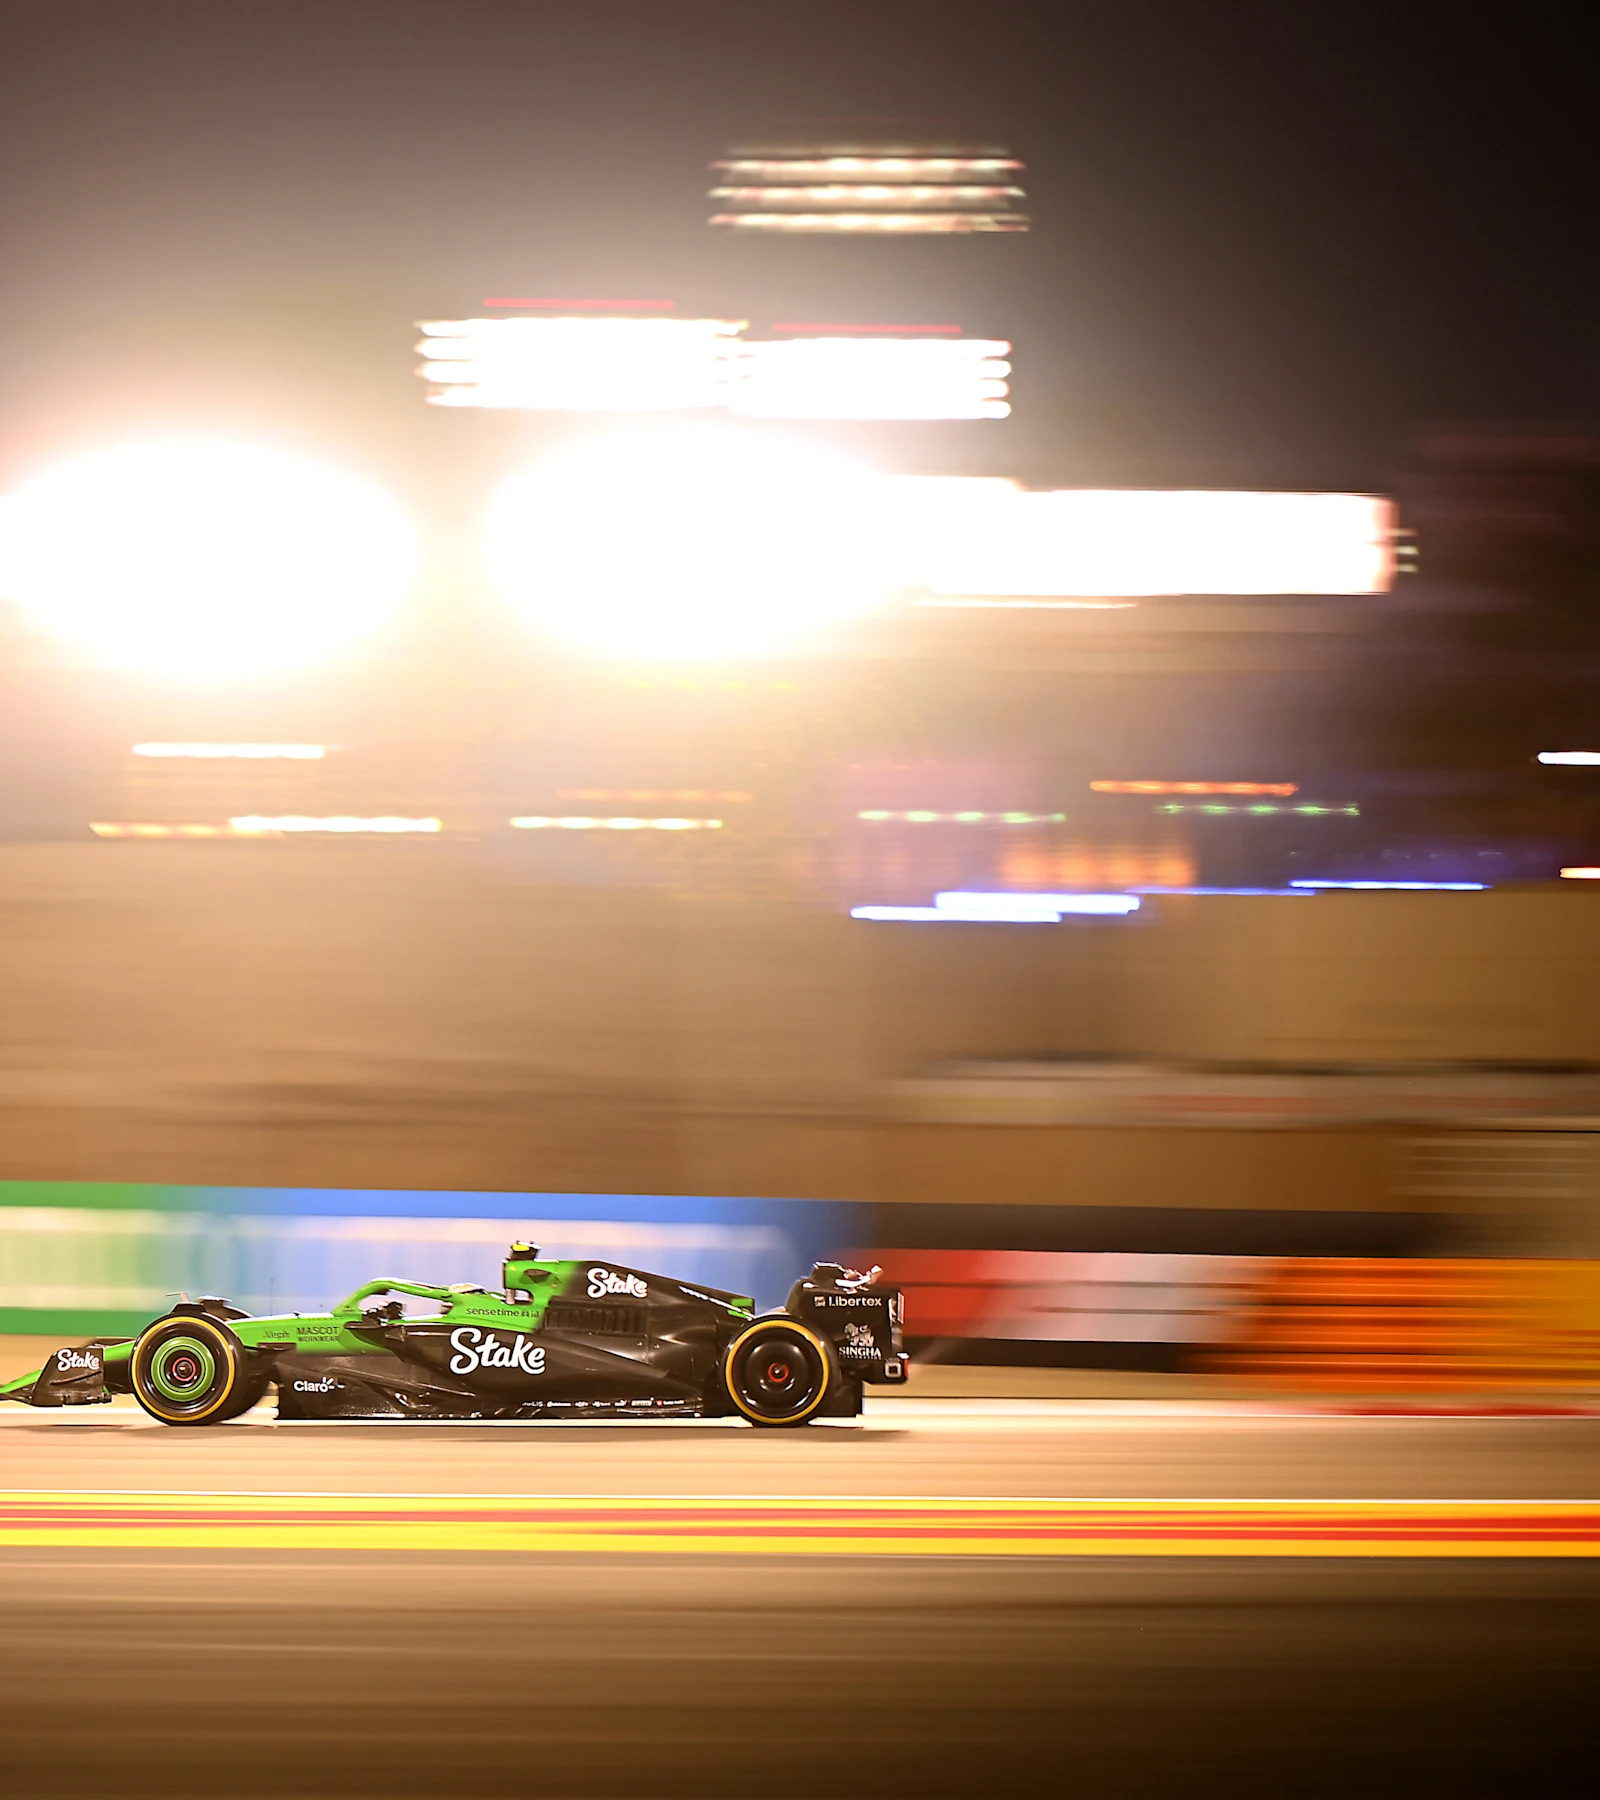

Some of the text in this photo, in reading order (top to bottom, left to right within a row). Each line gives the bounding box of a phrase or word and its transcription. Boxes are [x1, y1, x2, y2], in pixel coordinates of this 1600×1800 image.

[587, 1268, 648, 1298] Stake
[828, 1296, 882, 1307] Libertex
[466, 1307, 520, 1317] sensetime
[296, 1326, 340, 1336] MASCOT
[449, 1327, 546, 1375] Stake
[838, 1346, 881, 1357] SINGHA
[57, 1349, 100, 1371] Stake
[293, 1379, 330, 1393] Claro
